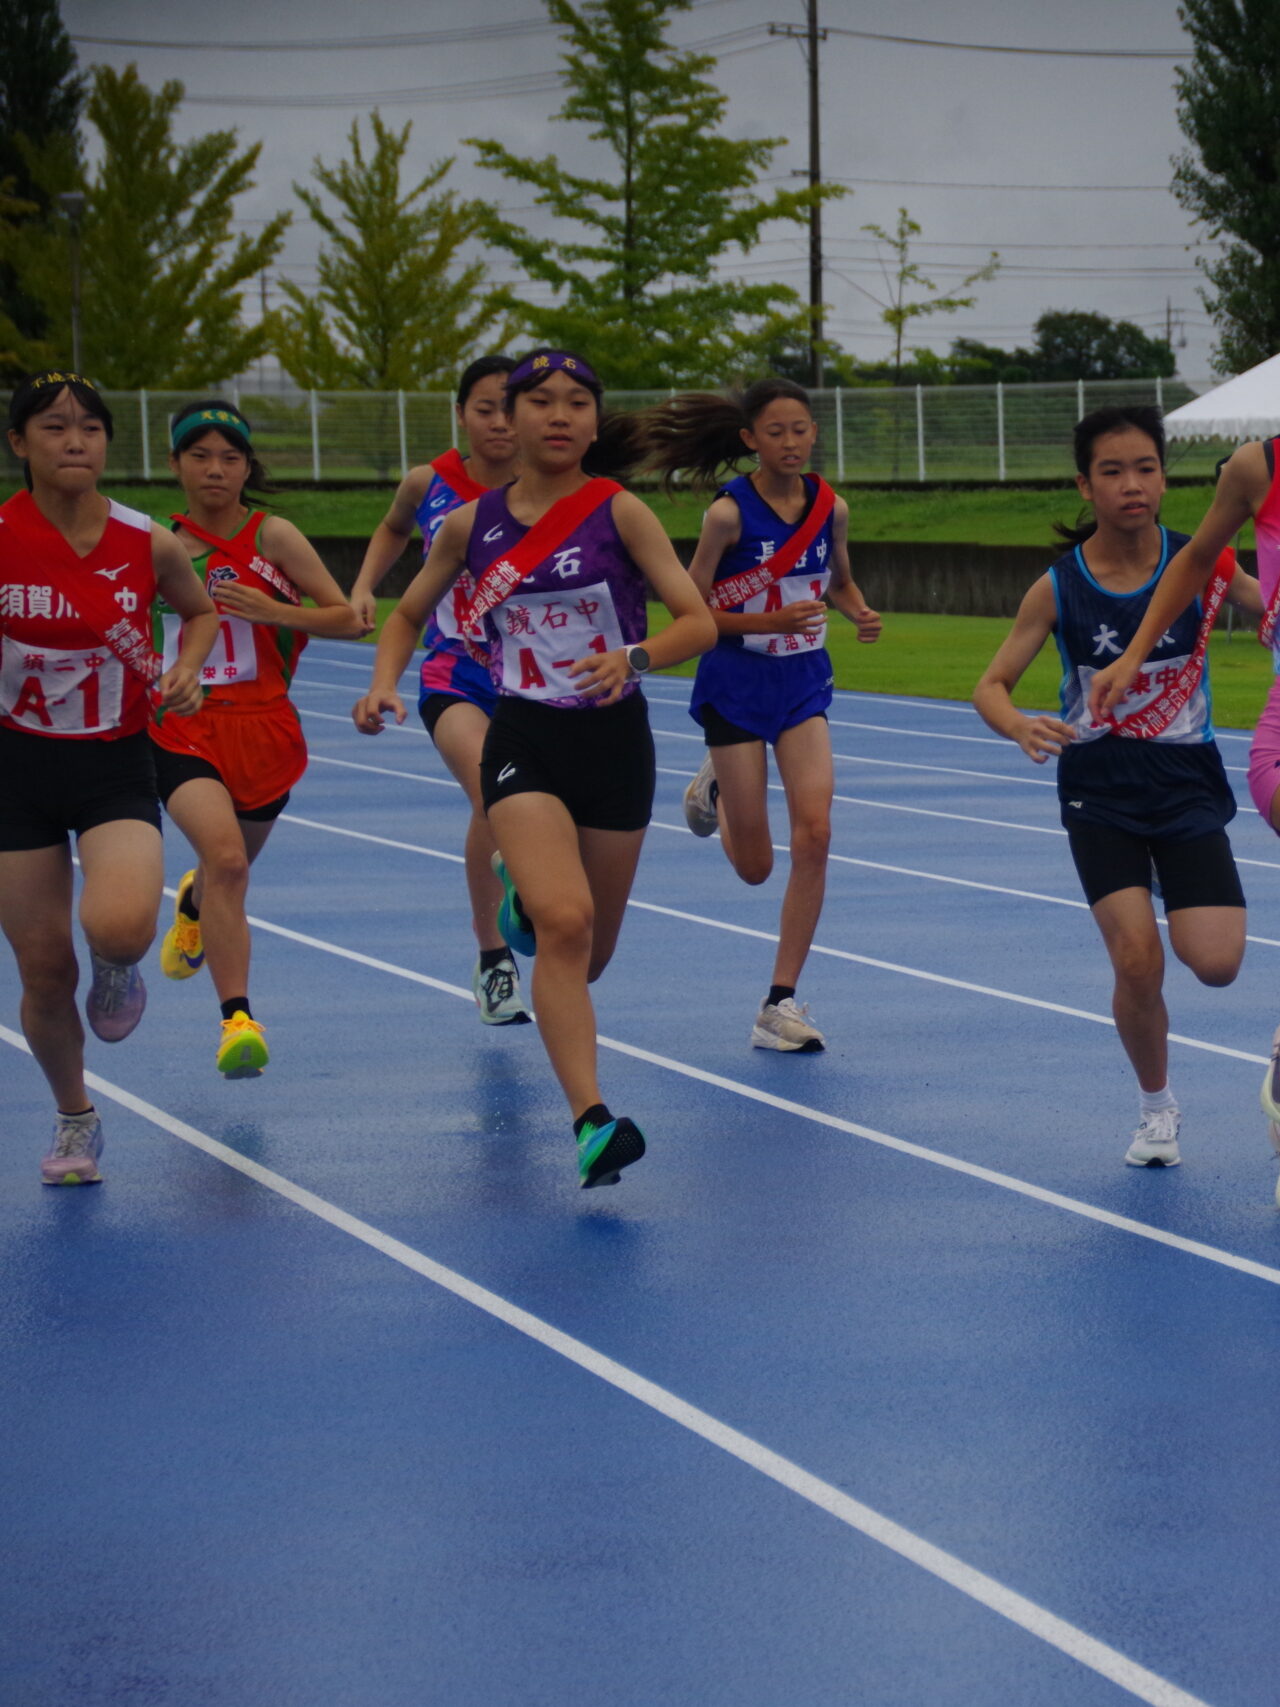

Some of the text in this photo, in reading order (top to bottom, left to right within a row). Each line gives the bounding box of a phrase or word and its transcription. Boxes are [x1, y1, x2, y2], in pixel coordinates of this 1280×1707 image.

[0, 584, 138, 620] 須賀川中
[506, 598, 599, 636] 鏡石中
[23, 652, 106, 672] 須二中
[203, 666, 237, 680] 栄中
[1127, 665, 1179, 696] 東中
[11, 671, 100, 729] A-1
